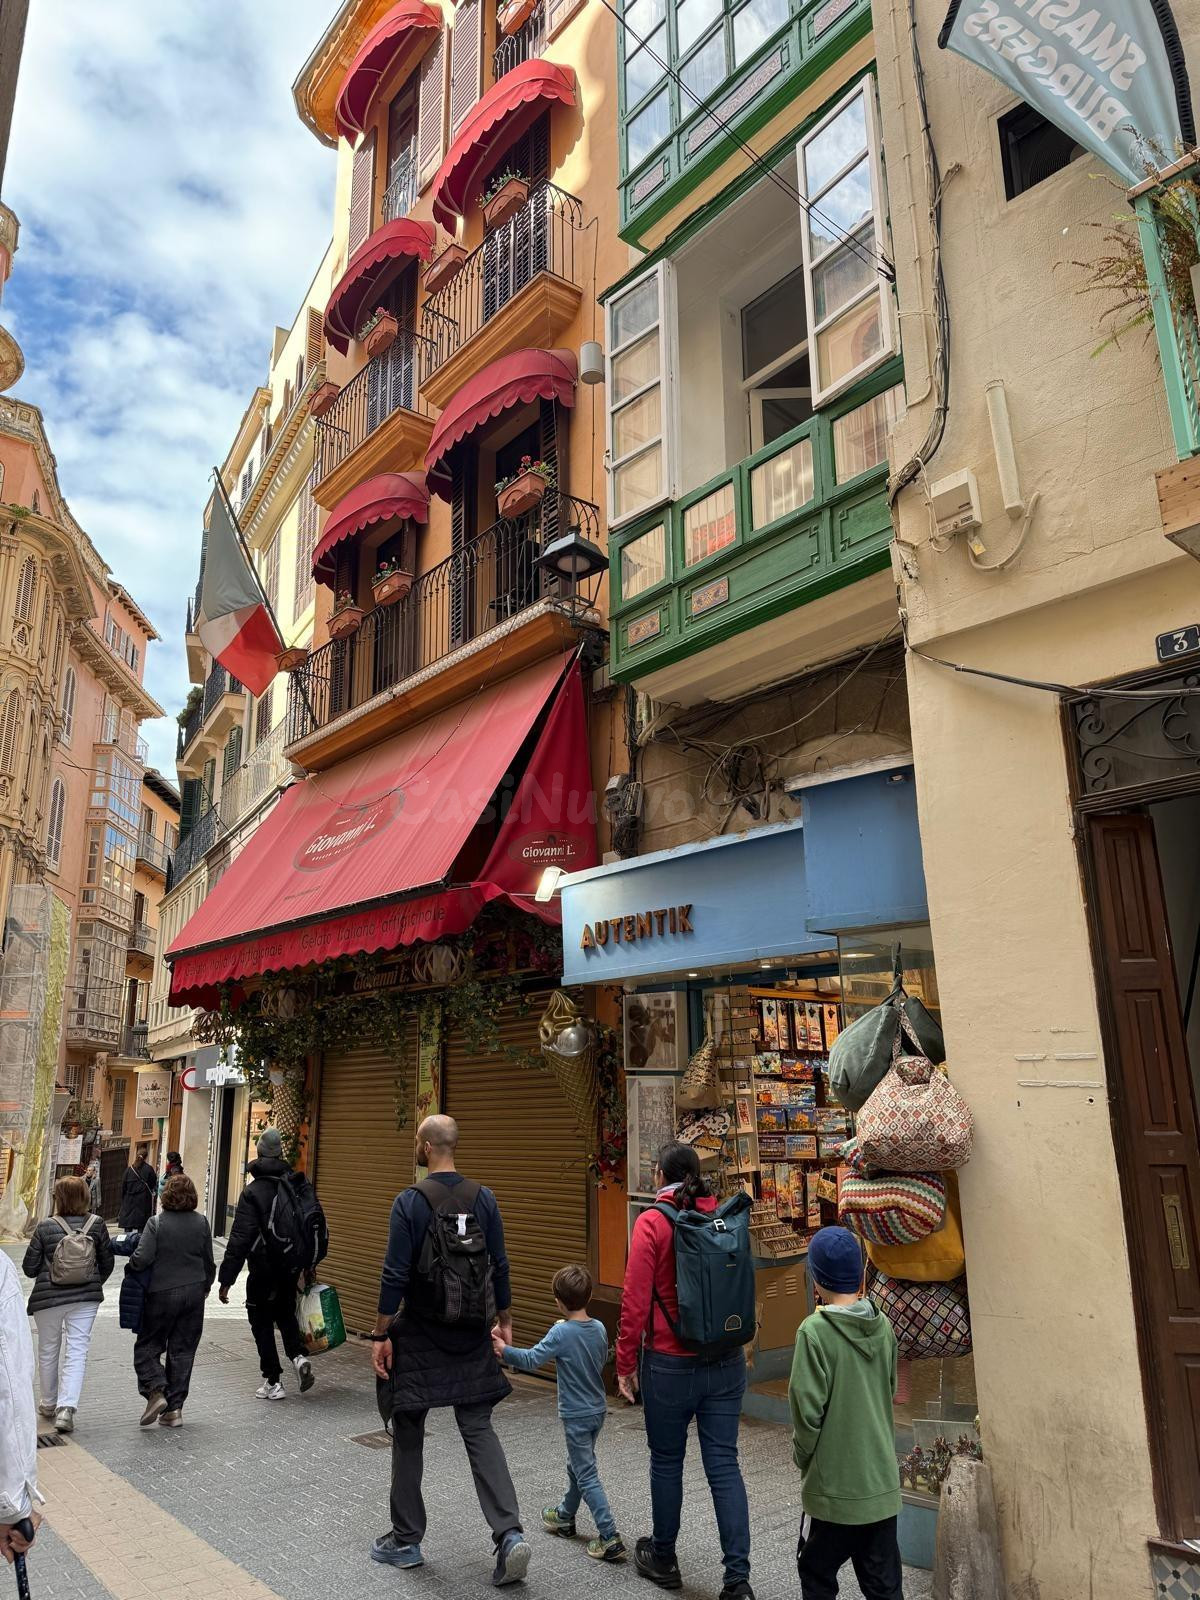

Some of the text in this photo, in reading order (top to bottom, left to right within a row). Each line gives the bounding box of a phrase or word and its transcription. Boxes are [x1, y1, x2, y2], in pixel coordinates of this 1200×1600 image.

[1173, 631, 1188, 652] 3
[305, 817, 371, 855] Giovanni
[522, 845, 565, 858] Giovanni
[580, 904, 694, 949] AUTENTIK
[301, 932, 331, 950] Gelato
